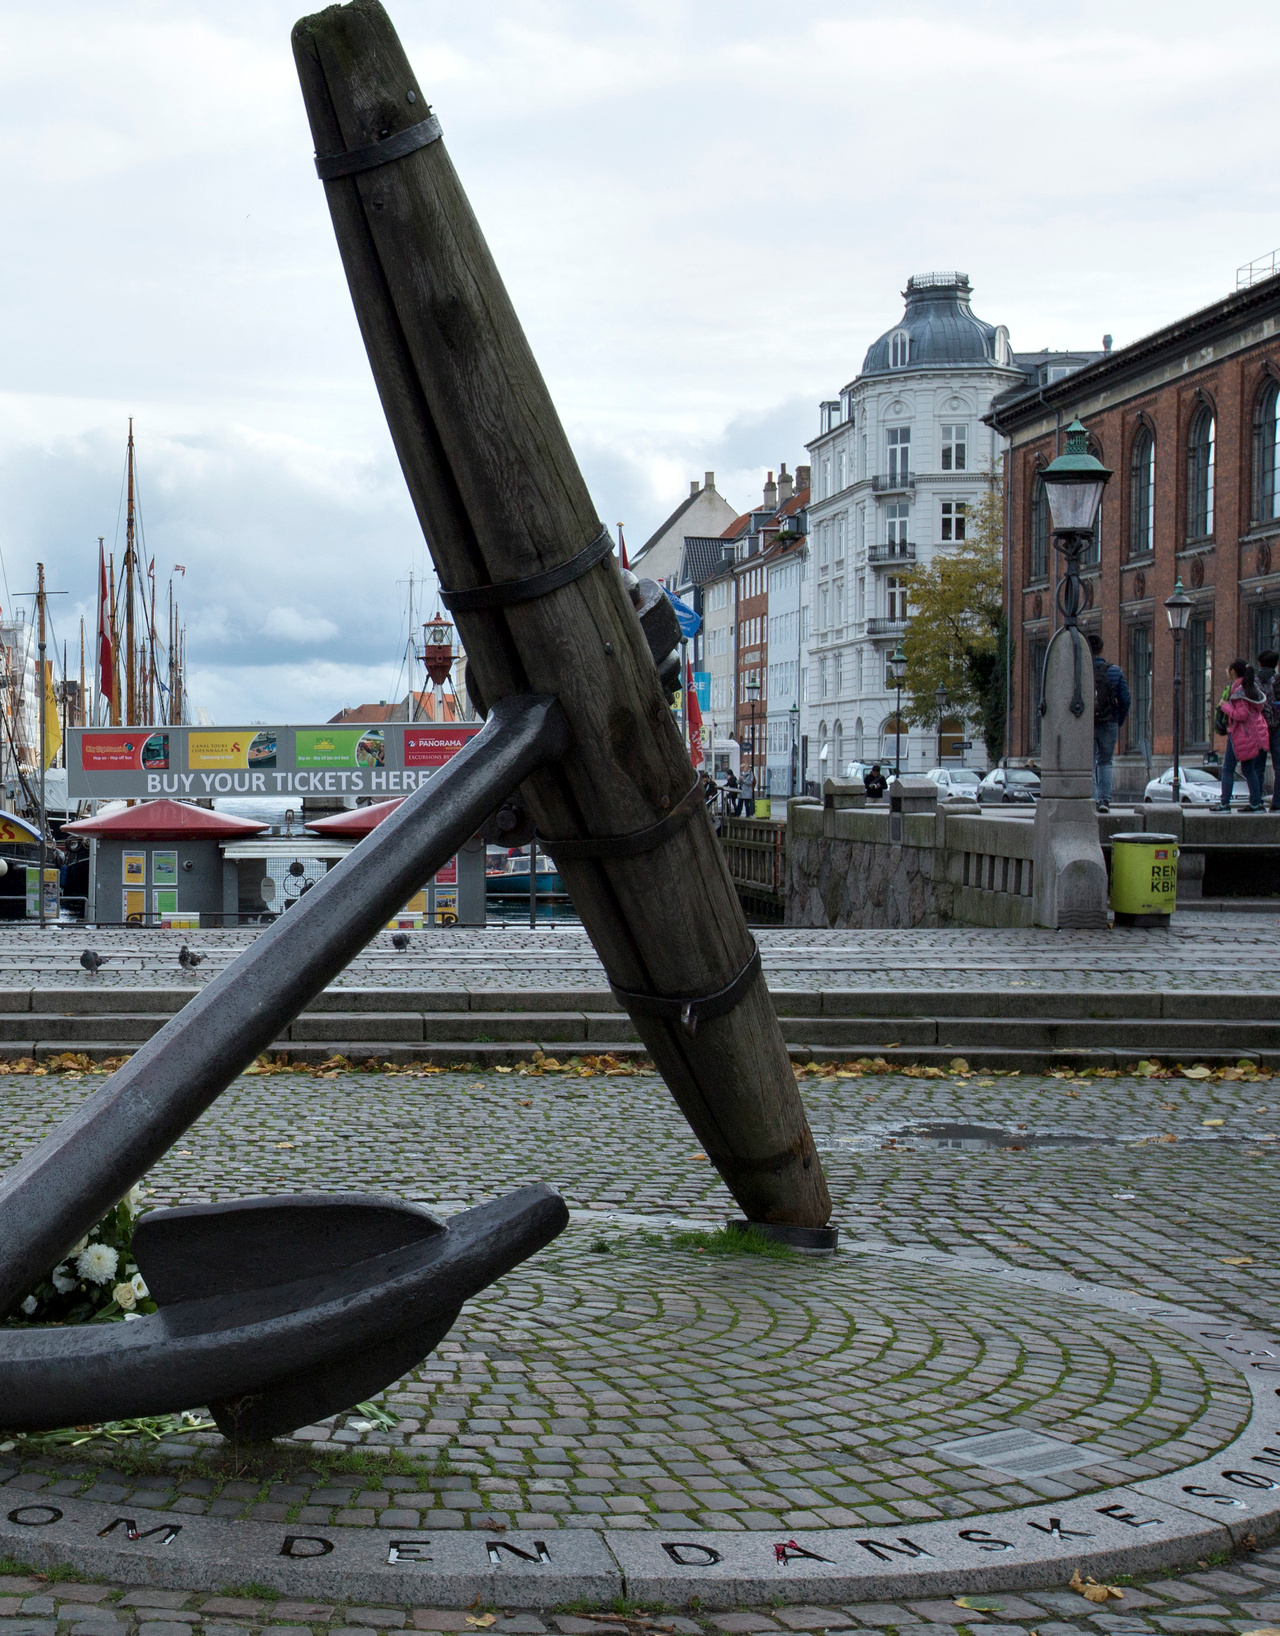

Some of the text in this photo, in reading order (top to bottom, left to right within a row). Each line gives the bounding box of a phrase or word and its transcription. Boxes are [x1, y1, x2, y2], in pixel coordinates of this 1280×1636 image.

[147, 770, 430, 793] BUY YOUR TICKETS HERE
[1151, 881, 1176, 893] KBH
[6, 1504, 184, 1546] OM
[279, 1534, 553, 1566] DEN
[659, 1503, 1165, 1568] DANSKE
